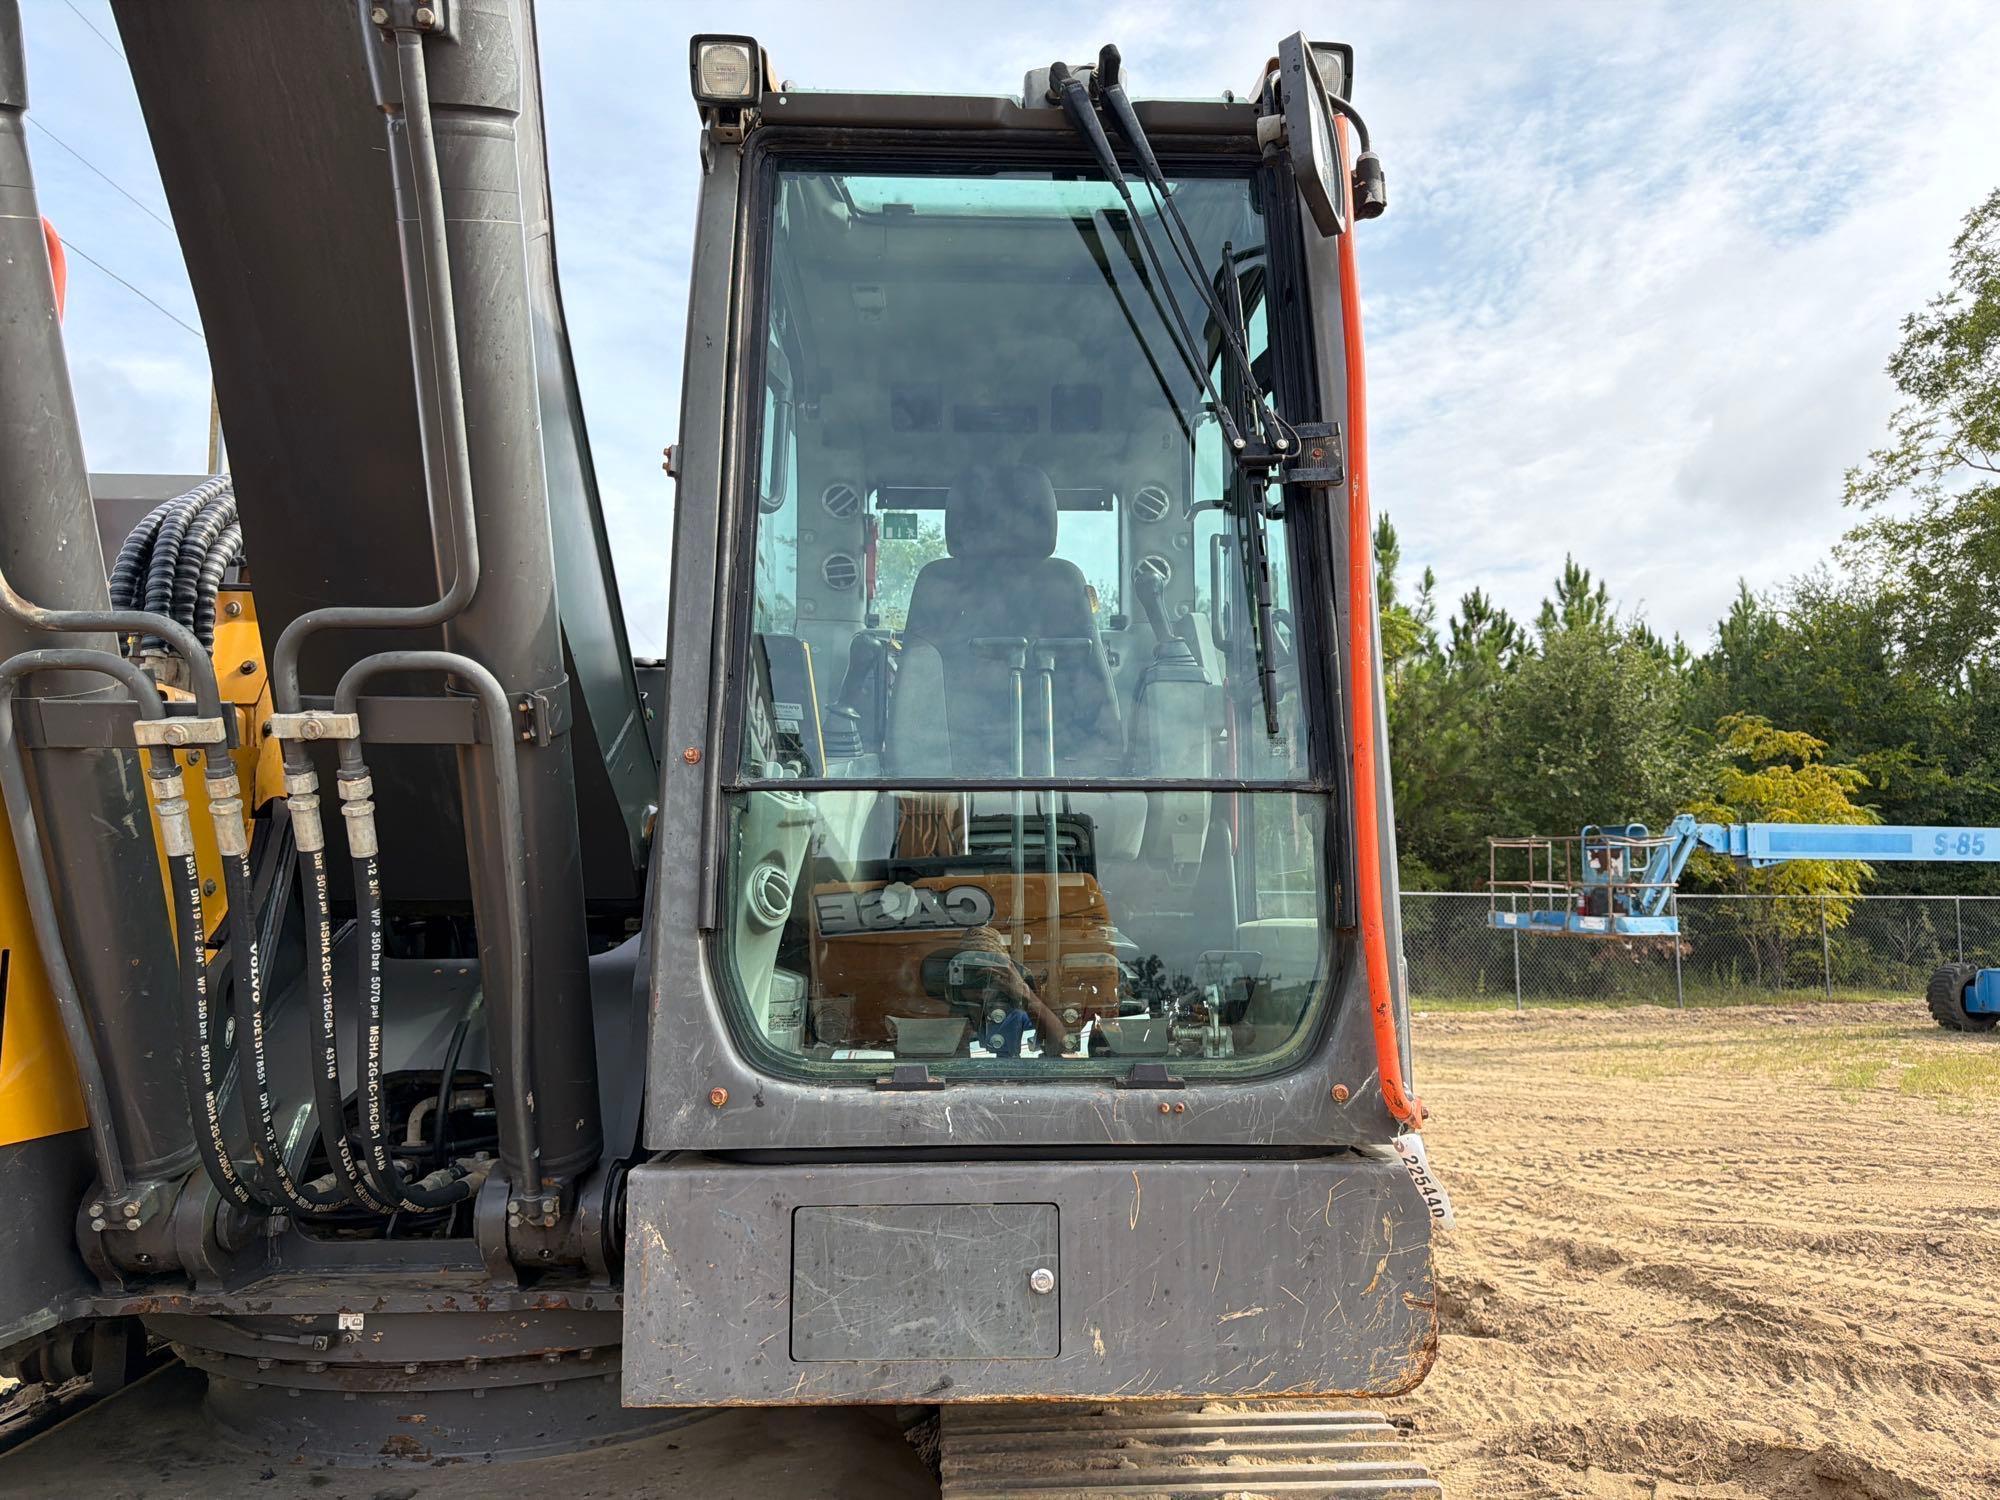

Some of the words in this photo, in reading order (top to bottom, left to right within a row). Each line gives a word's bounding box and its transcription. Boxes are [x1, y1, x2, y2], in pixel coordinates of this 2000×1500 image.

[1933, 832, 1985, 856] S-85
[314, 853, 322, 869] bar
[368, 859, 377, 875] -12
[190, 888, 201, 904] DN
[192, 907, 202, 919] 19
[319, 902, 328, 914] psi
[371, 908, 380, 926] WP
[194, 924, 203, 941] -12
[320, 922, 330, 954] MSHA
[371, 932, 381, 950] 350
[371, 953, 381, 971] bar
[250, 941, 260, 1003] VOLVO
[197, 976, 206, 994] WP
[370, 977, 380, 1002] 5070
[198, 1000, 207, 1019] 350
[370, 1005, 379, 1018] psi
[199, 1022, 208, 1039] bar
[368, 1026, 379, 1059] MSHA
[200, 1045, 210, 1070] 5070
[325, 1047, 336, 1079] 43148
[203, 1072, 212, 1085] psi
[205, 1091, 217, 1124] MSHA
[259, 1092, 269, 1109] DN
[262, 1110, 270, 1123] 19
[337, 1135, 356, 1180] VOLVO
[1402, 1155, 1445, 1218] 225440
